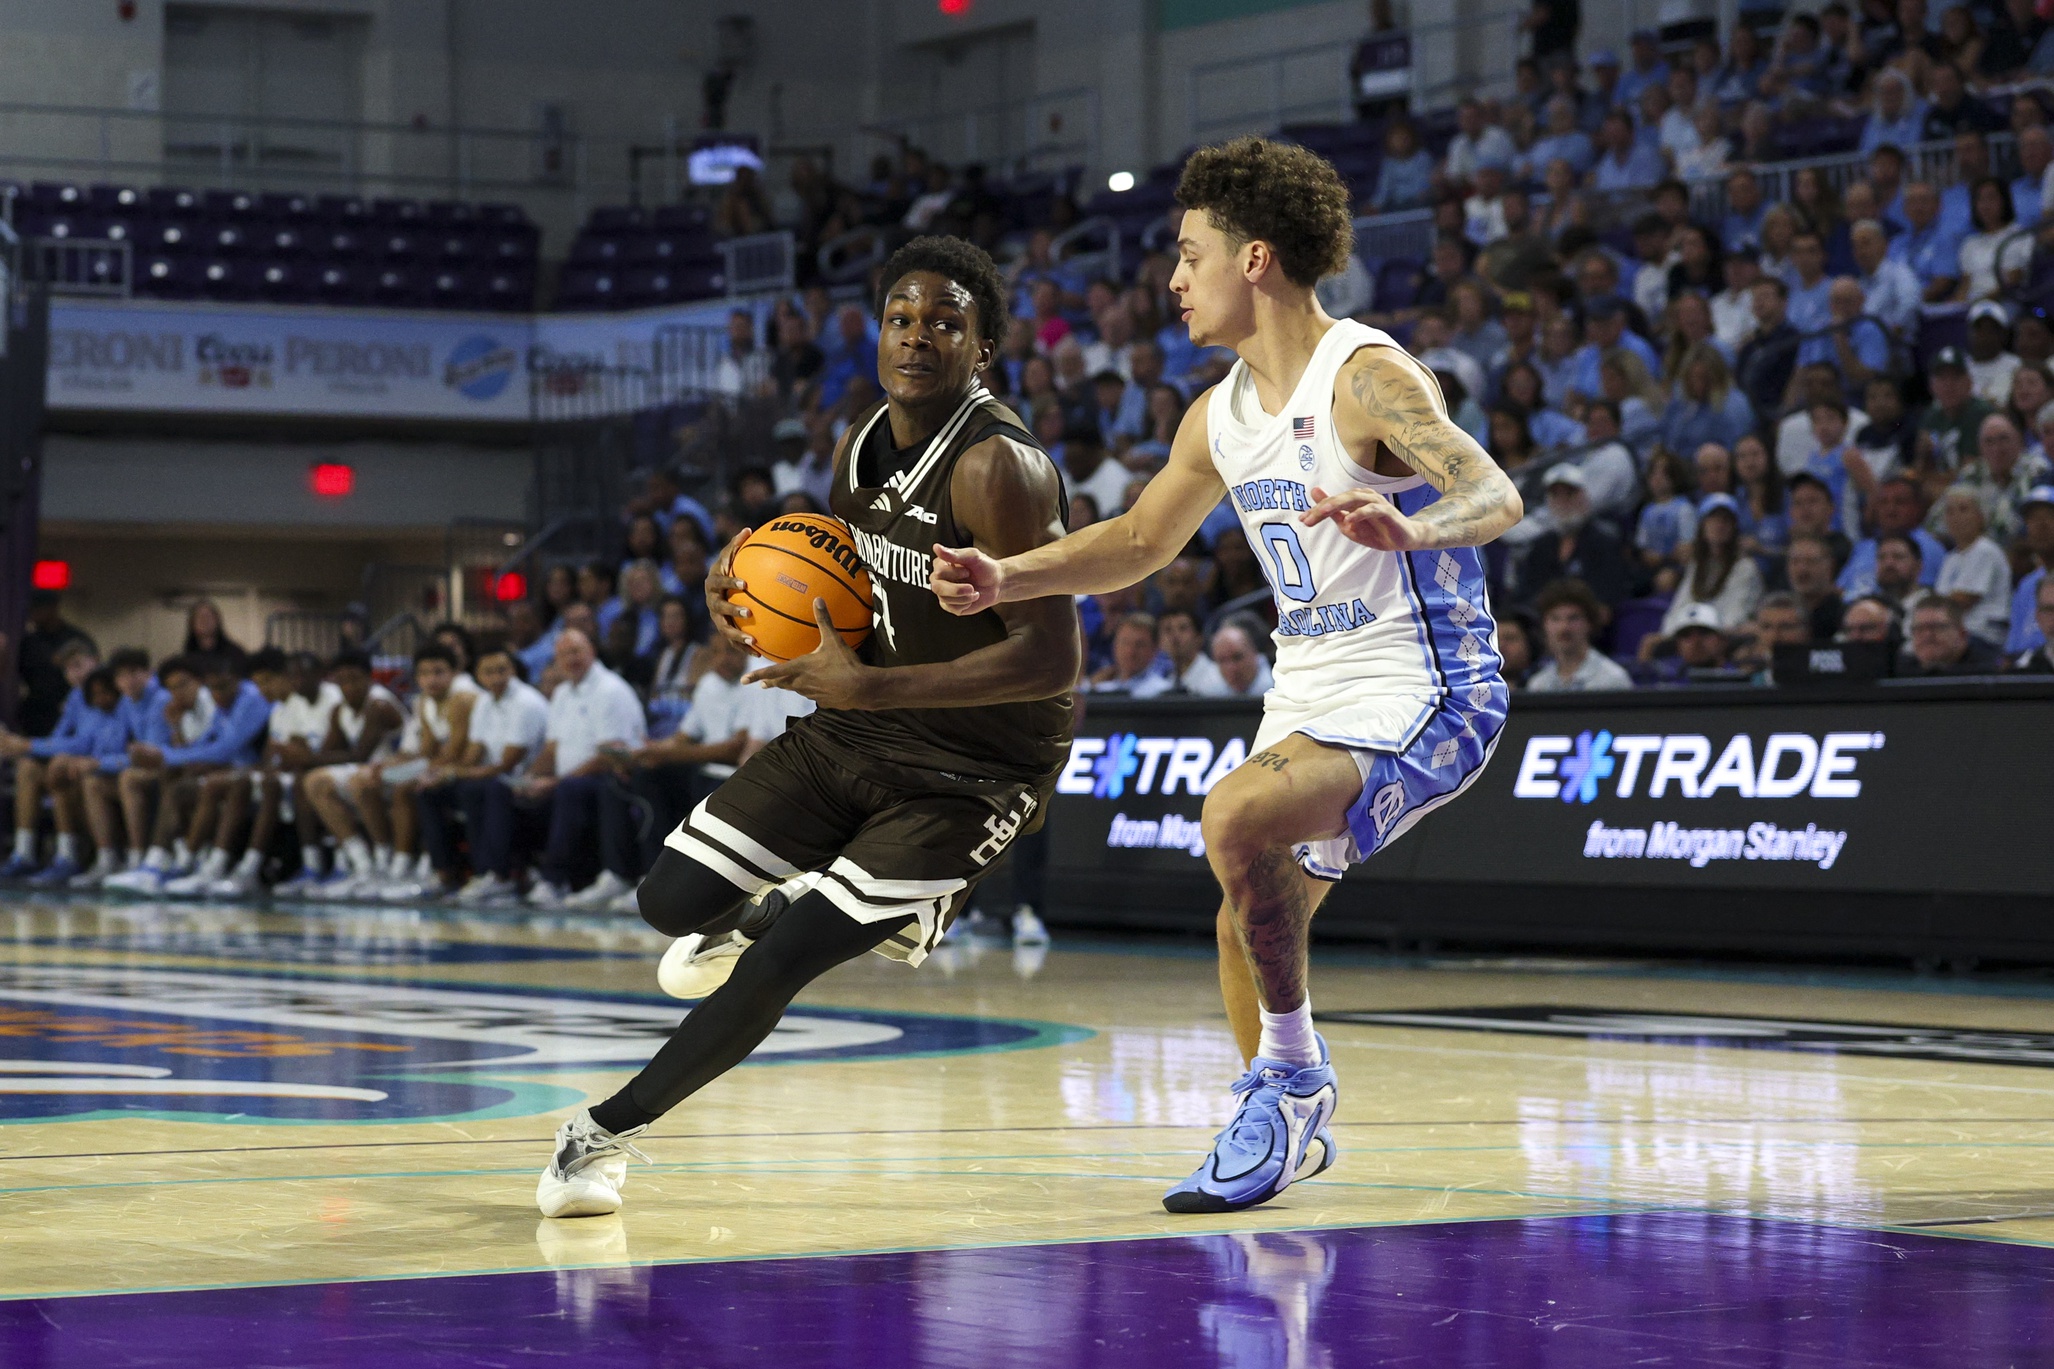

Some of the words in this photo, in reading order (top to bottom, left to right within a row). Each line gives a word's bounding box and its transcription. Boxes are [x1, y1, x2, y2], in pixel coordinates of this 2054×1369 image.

[1232, 479, 1311, 512] NORTH
[770, 521, 861, 579] Wilson
[1260, 522, 1317, 603] 0
[1106, 813, 1160, 848] from
[1583, 819, 1648, 858] from
[1646, 820, 1746, 868] Morgan
[1743, 821, 1845, 870] Stanley
